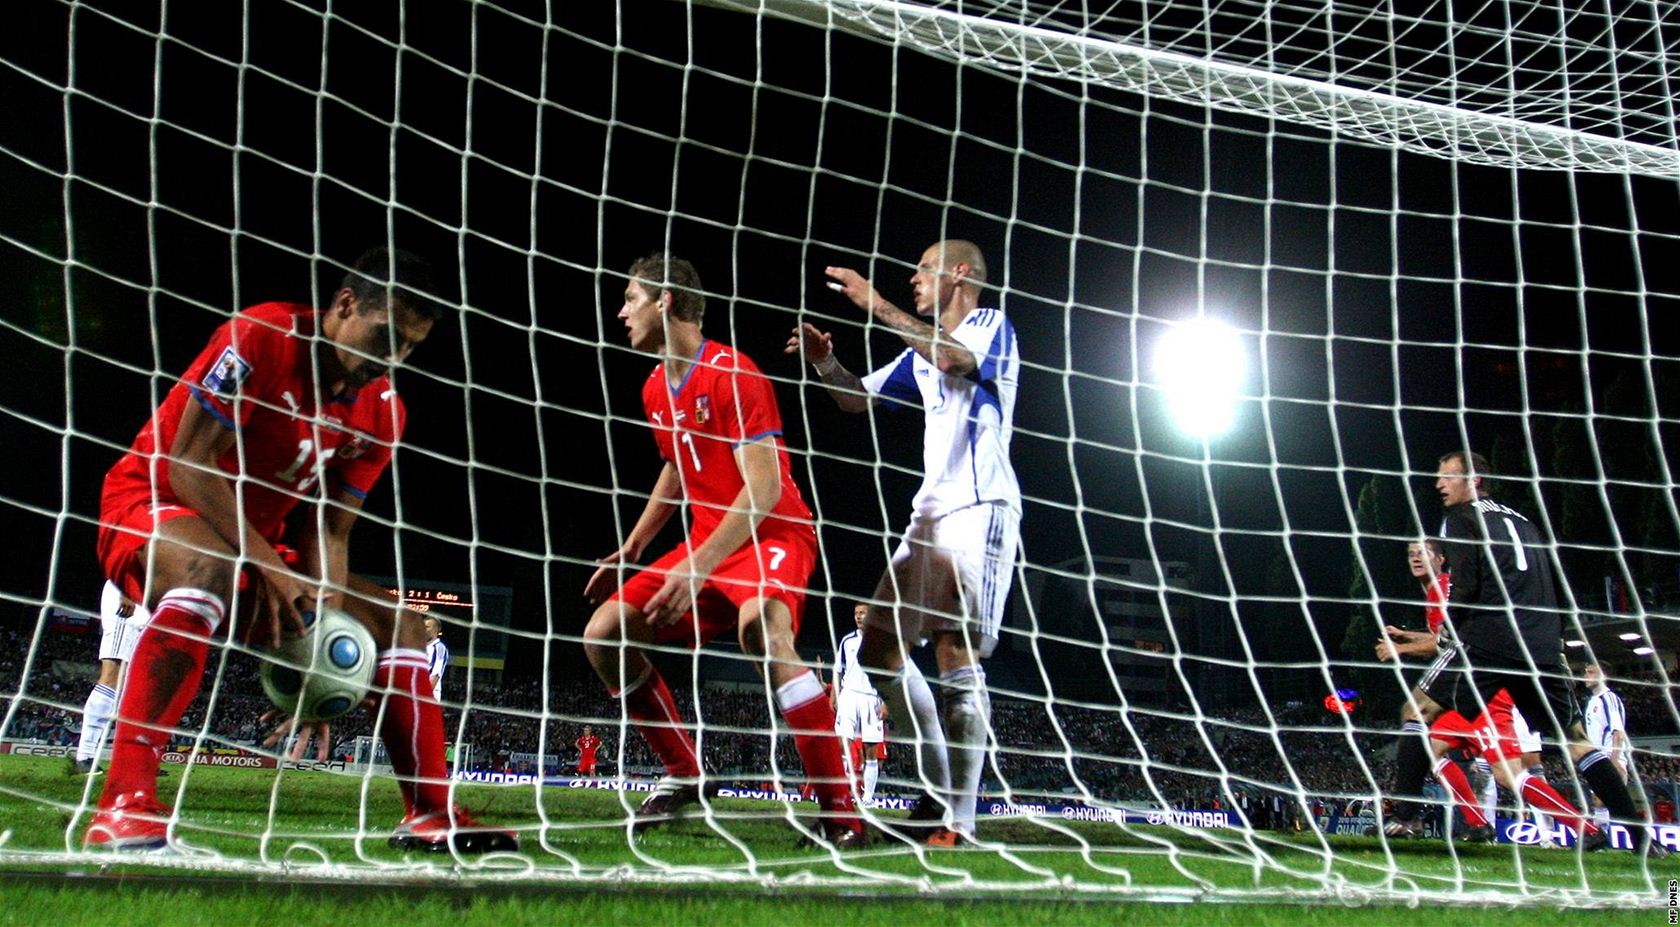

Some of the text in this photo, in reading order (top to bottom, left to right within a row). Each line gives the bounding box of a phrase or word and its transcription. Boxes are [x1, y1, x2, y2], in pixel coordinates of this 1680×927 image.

[275, 439, 336, 490] 15
[768, 547, 787, 570] 7
[1503, 517, 1527, 570] 1
[211, 756, 262, 767] MOTORS
